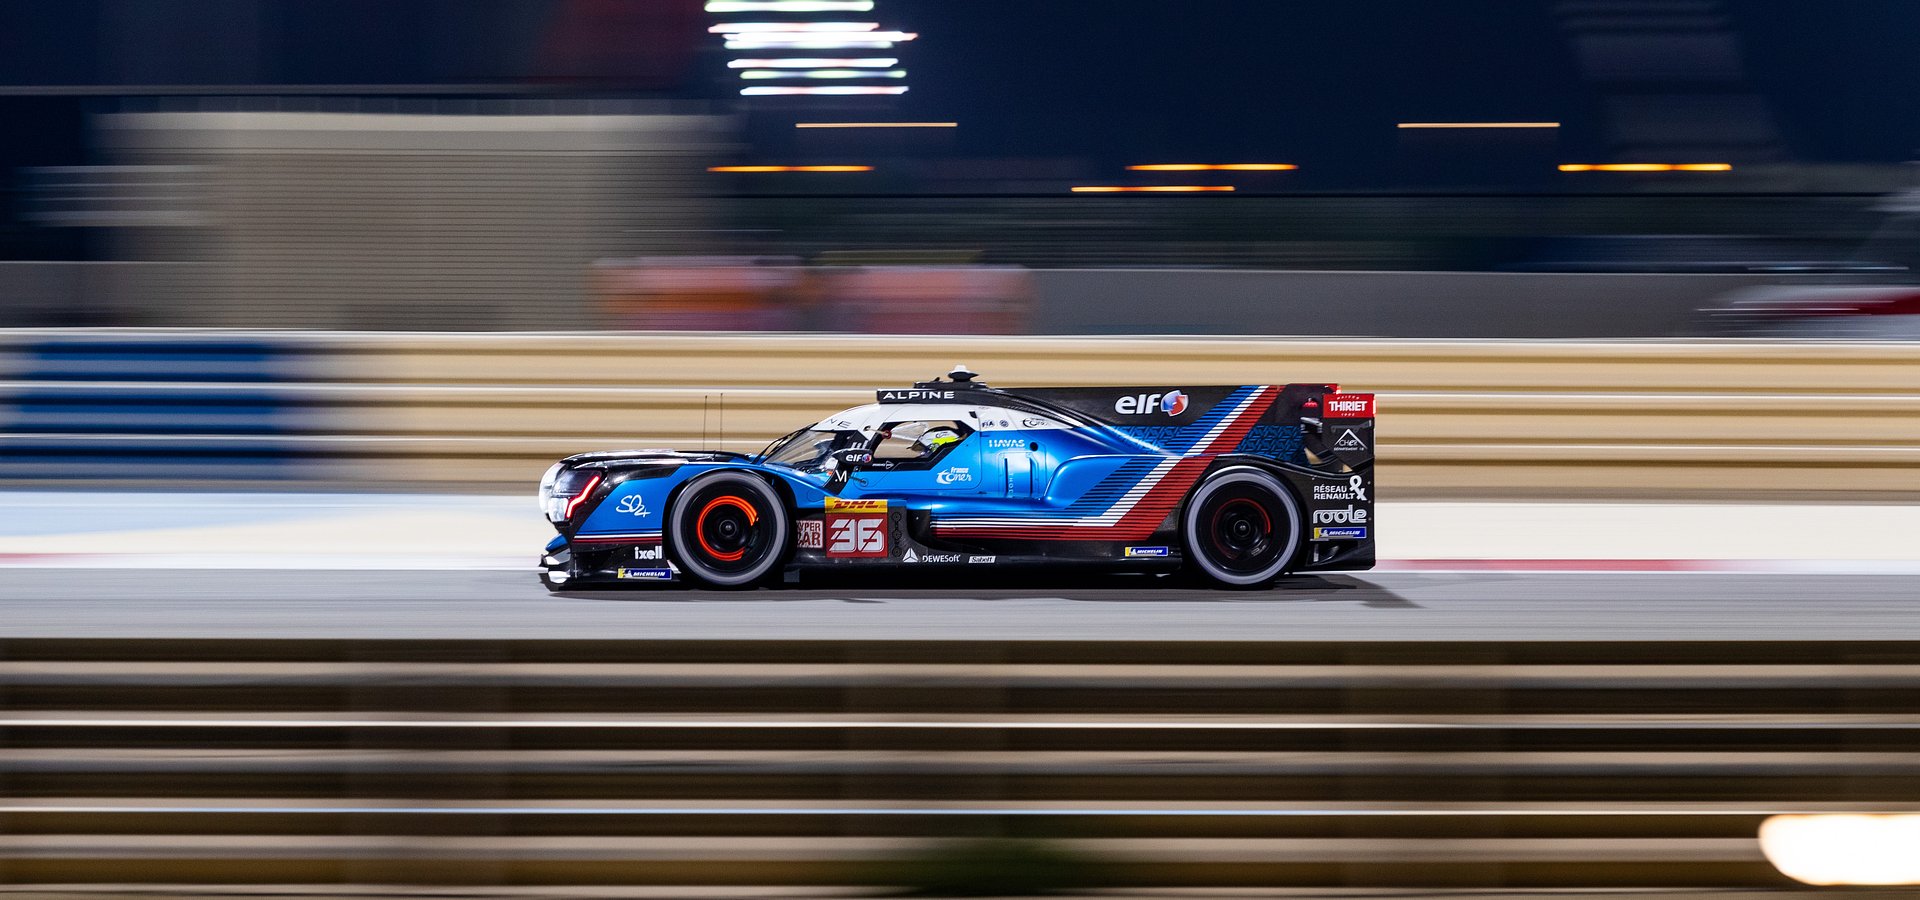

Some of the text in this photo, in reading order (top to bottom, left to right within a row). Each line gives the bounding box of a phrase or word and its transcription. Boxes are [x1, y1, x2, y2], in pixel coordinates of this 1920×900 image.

[883, 391, 955, 400] ALPINE
[1115, 394, 1161, 414] elf
[1328, 401, 1368, 412] THIRIET
[989, 439, 1025, 448] HAVAS
[845, 454, 862, 462] elf
[1313, 483, 1348, 493] RÉSEAU
[833, 500, 879, 509] DHL
[1312, 504, 1367, 524] roole
[797, 522, 821, 532] YPER
[829, 518, 885, 553] 36
[634, 545, 663, 560] ixell
